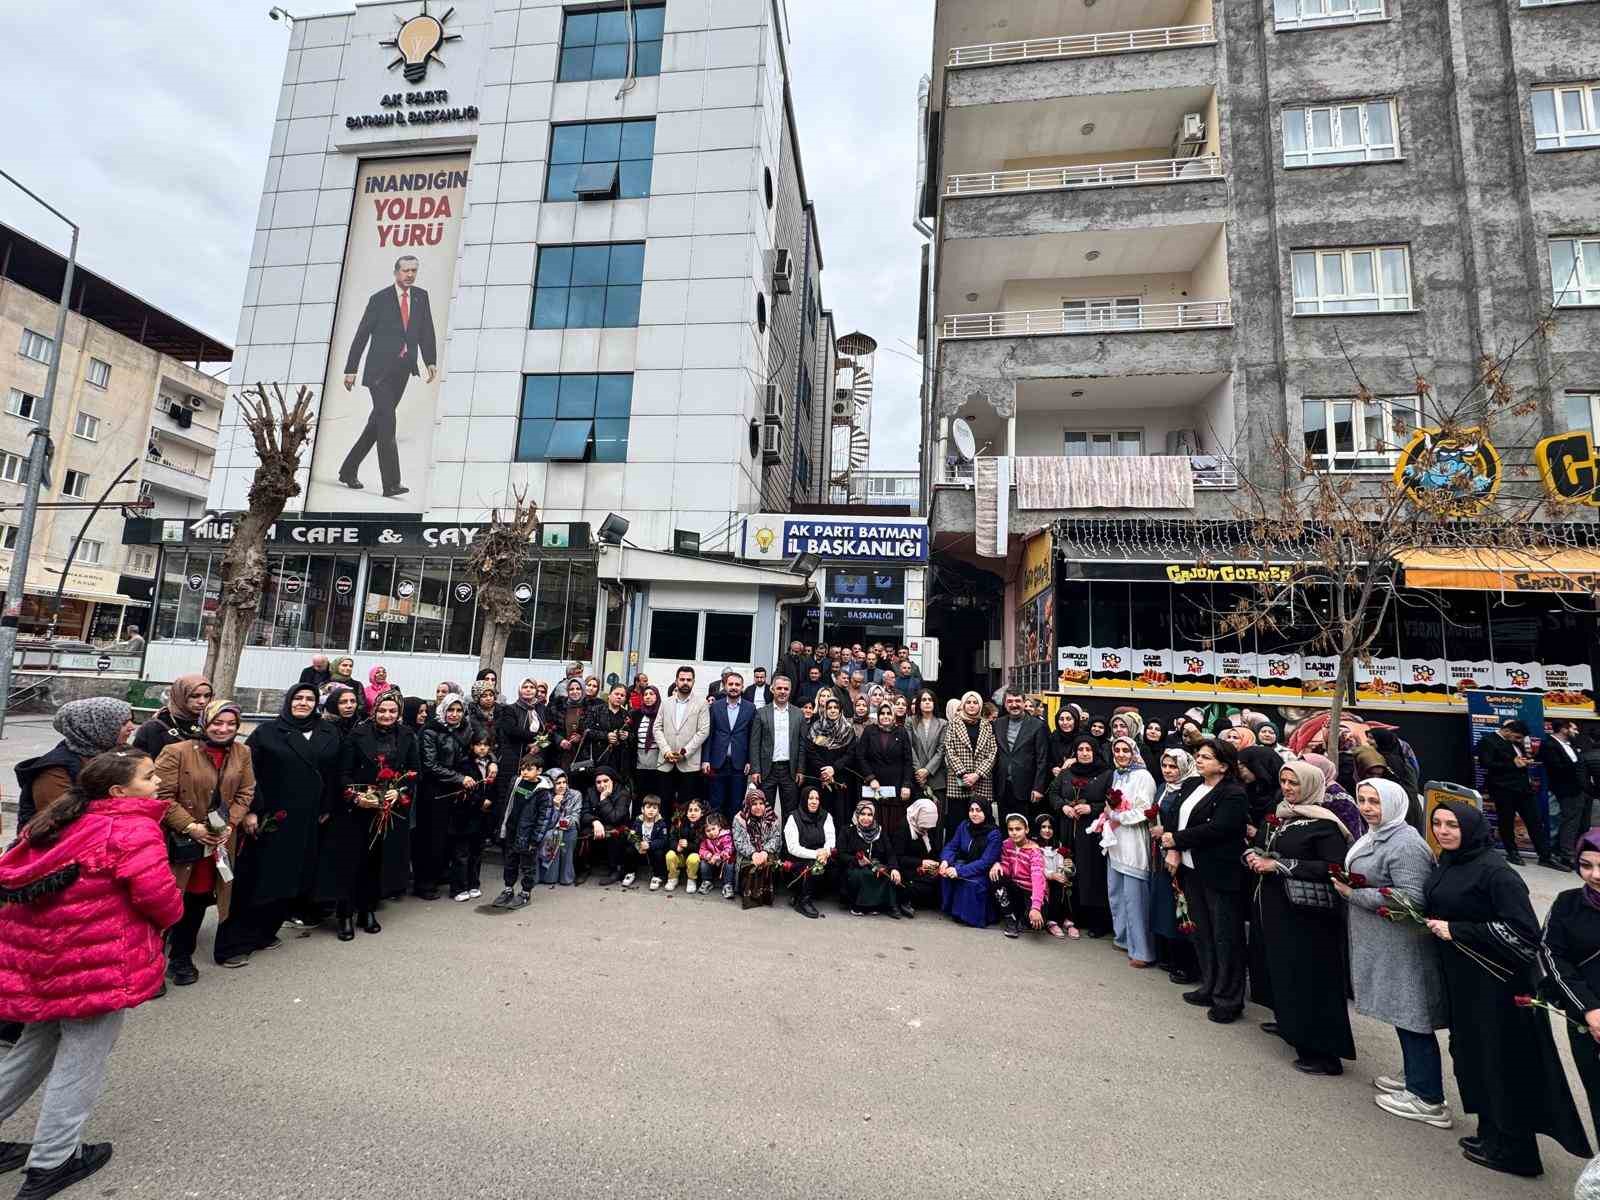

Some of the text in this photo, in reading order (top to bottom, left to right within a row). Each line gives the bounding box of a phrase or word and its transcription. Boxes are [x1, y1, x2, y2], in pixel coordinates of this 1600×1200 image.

[380, 92, 403, 107] AK
[345, 112, 395, 130] BATMAN
[407, 105, 479, 125] BAŞKANLIĞI
[374, 195, 452, 221] YOLDA
[377, 222, 444, 248] YÜRÜ
[291, 527, 360, 543] CAFE
[378, 528, 404, 544] &
[788, 525, 810, 537] AK
[859, 526, 922, 540] BATMAN
[807, 539, 921, 557] BAŞKANLIĞI
[847, 611, 894, 620] BAŞKANLIĞI
[1101, 652, 1122, 664] FOOD
[1183, 656, 1205, 667] FOOD
[1268, 659, 1290, 670] FOOD
[1305, 662, 1335, 671] CAJUN
[1412, 664, 1436, 676] FOOD
[1505, 668, 1530, 680] FOOD
